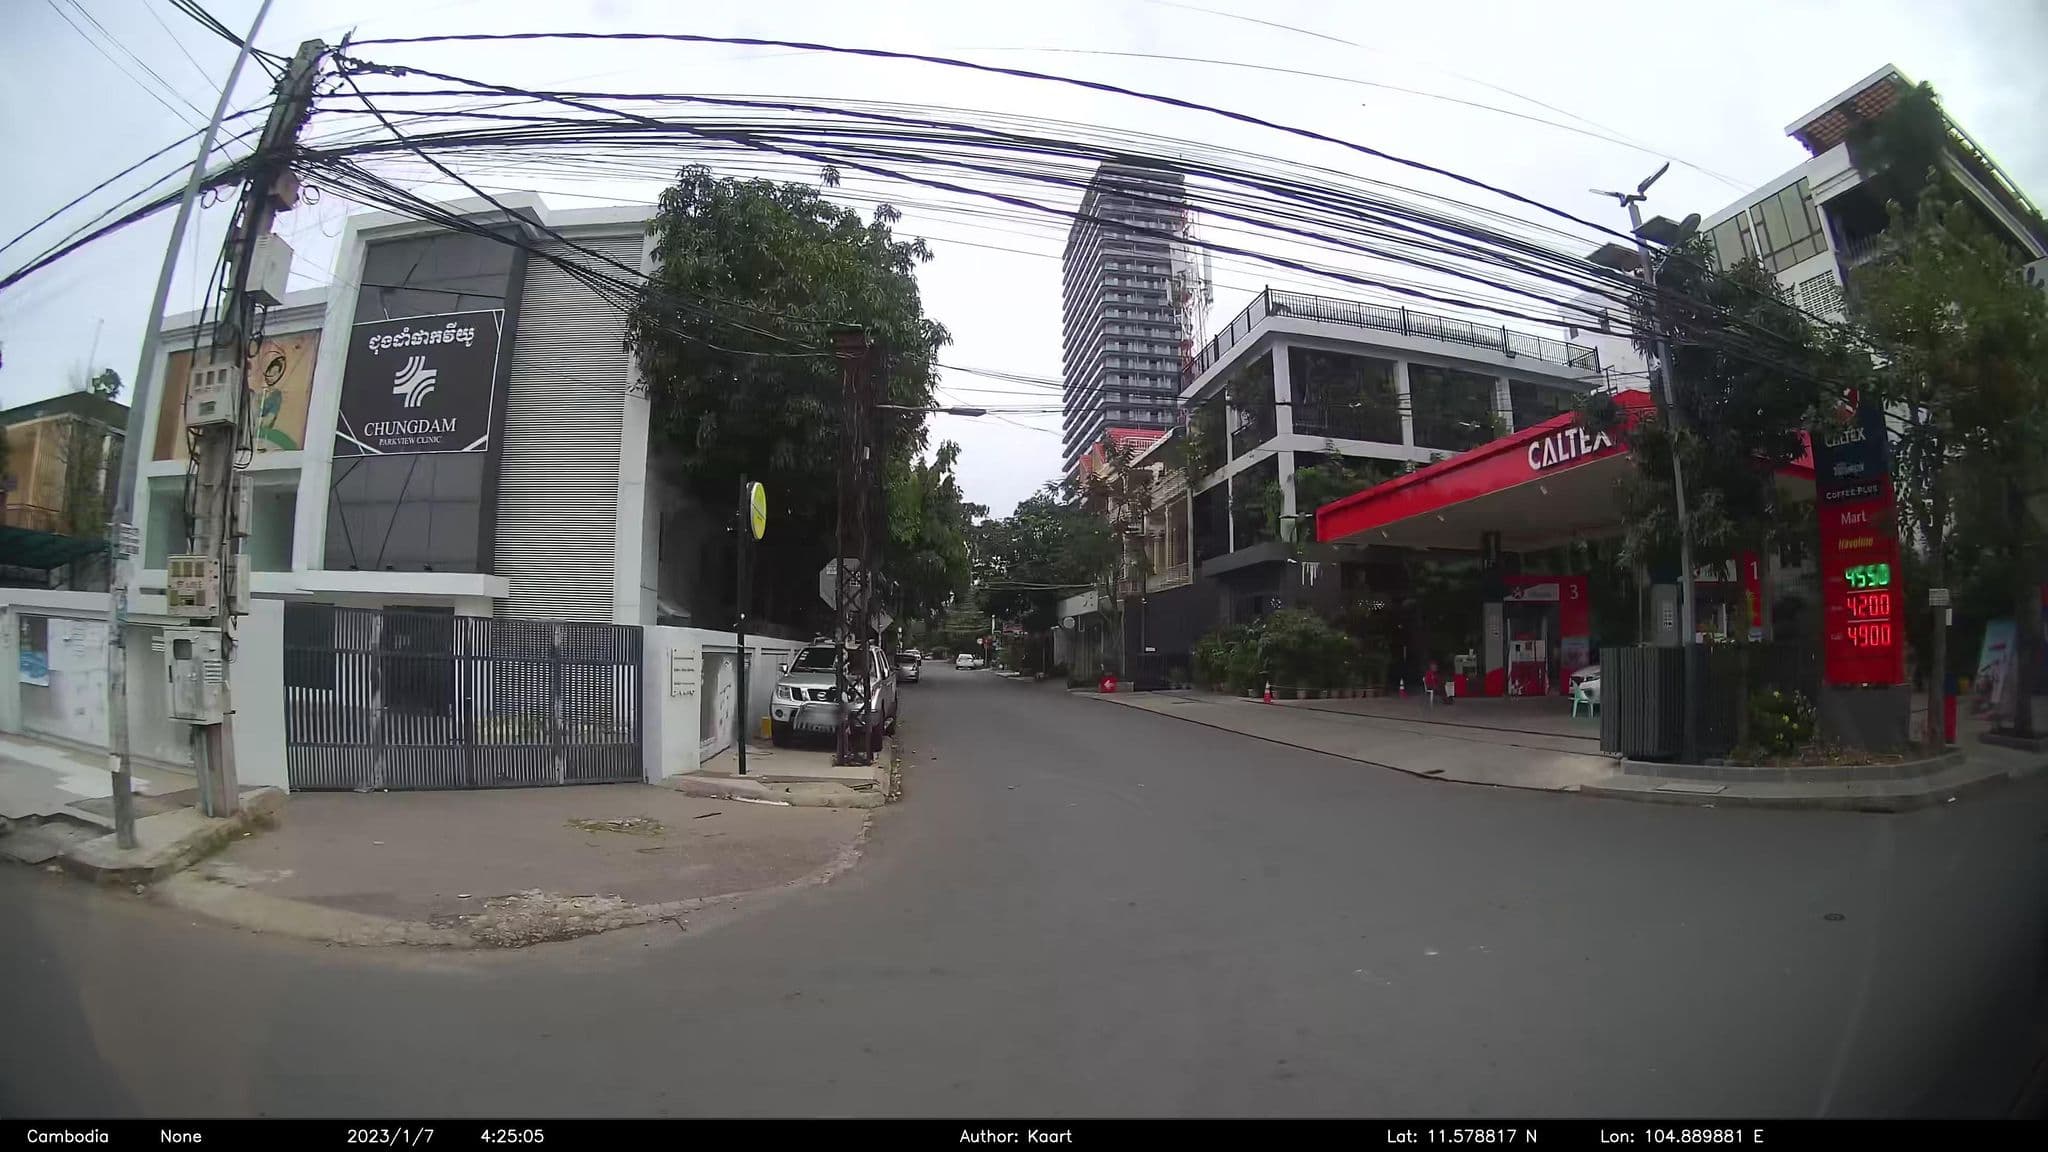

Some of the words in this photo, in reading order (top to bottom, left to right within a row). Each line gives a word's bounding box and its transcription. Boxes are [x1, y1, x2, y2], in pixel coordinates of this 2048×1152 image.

[364, 418, 457, 437] CHUNGDAM
[416, 436, 442, 444] CLINIC
[1841, 510, 1867, 525] Mart
[1750, 561, 1758, 580] 1
[1845, 564, 1890, 588] 4550
[1569, 584, 1579, 600] 3
[1847, 594, 1890, 616] 4200
[1847, 625, 1891, 647] 4900
